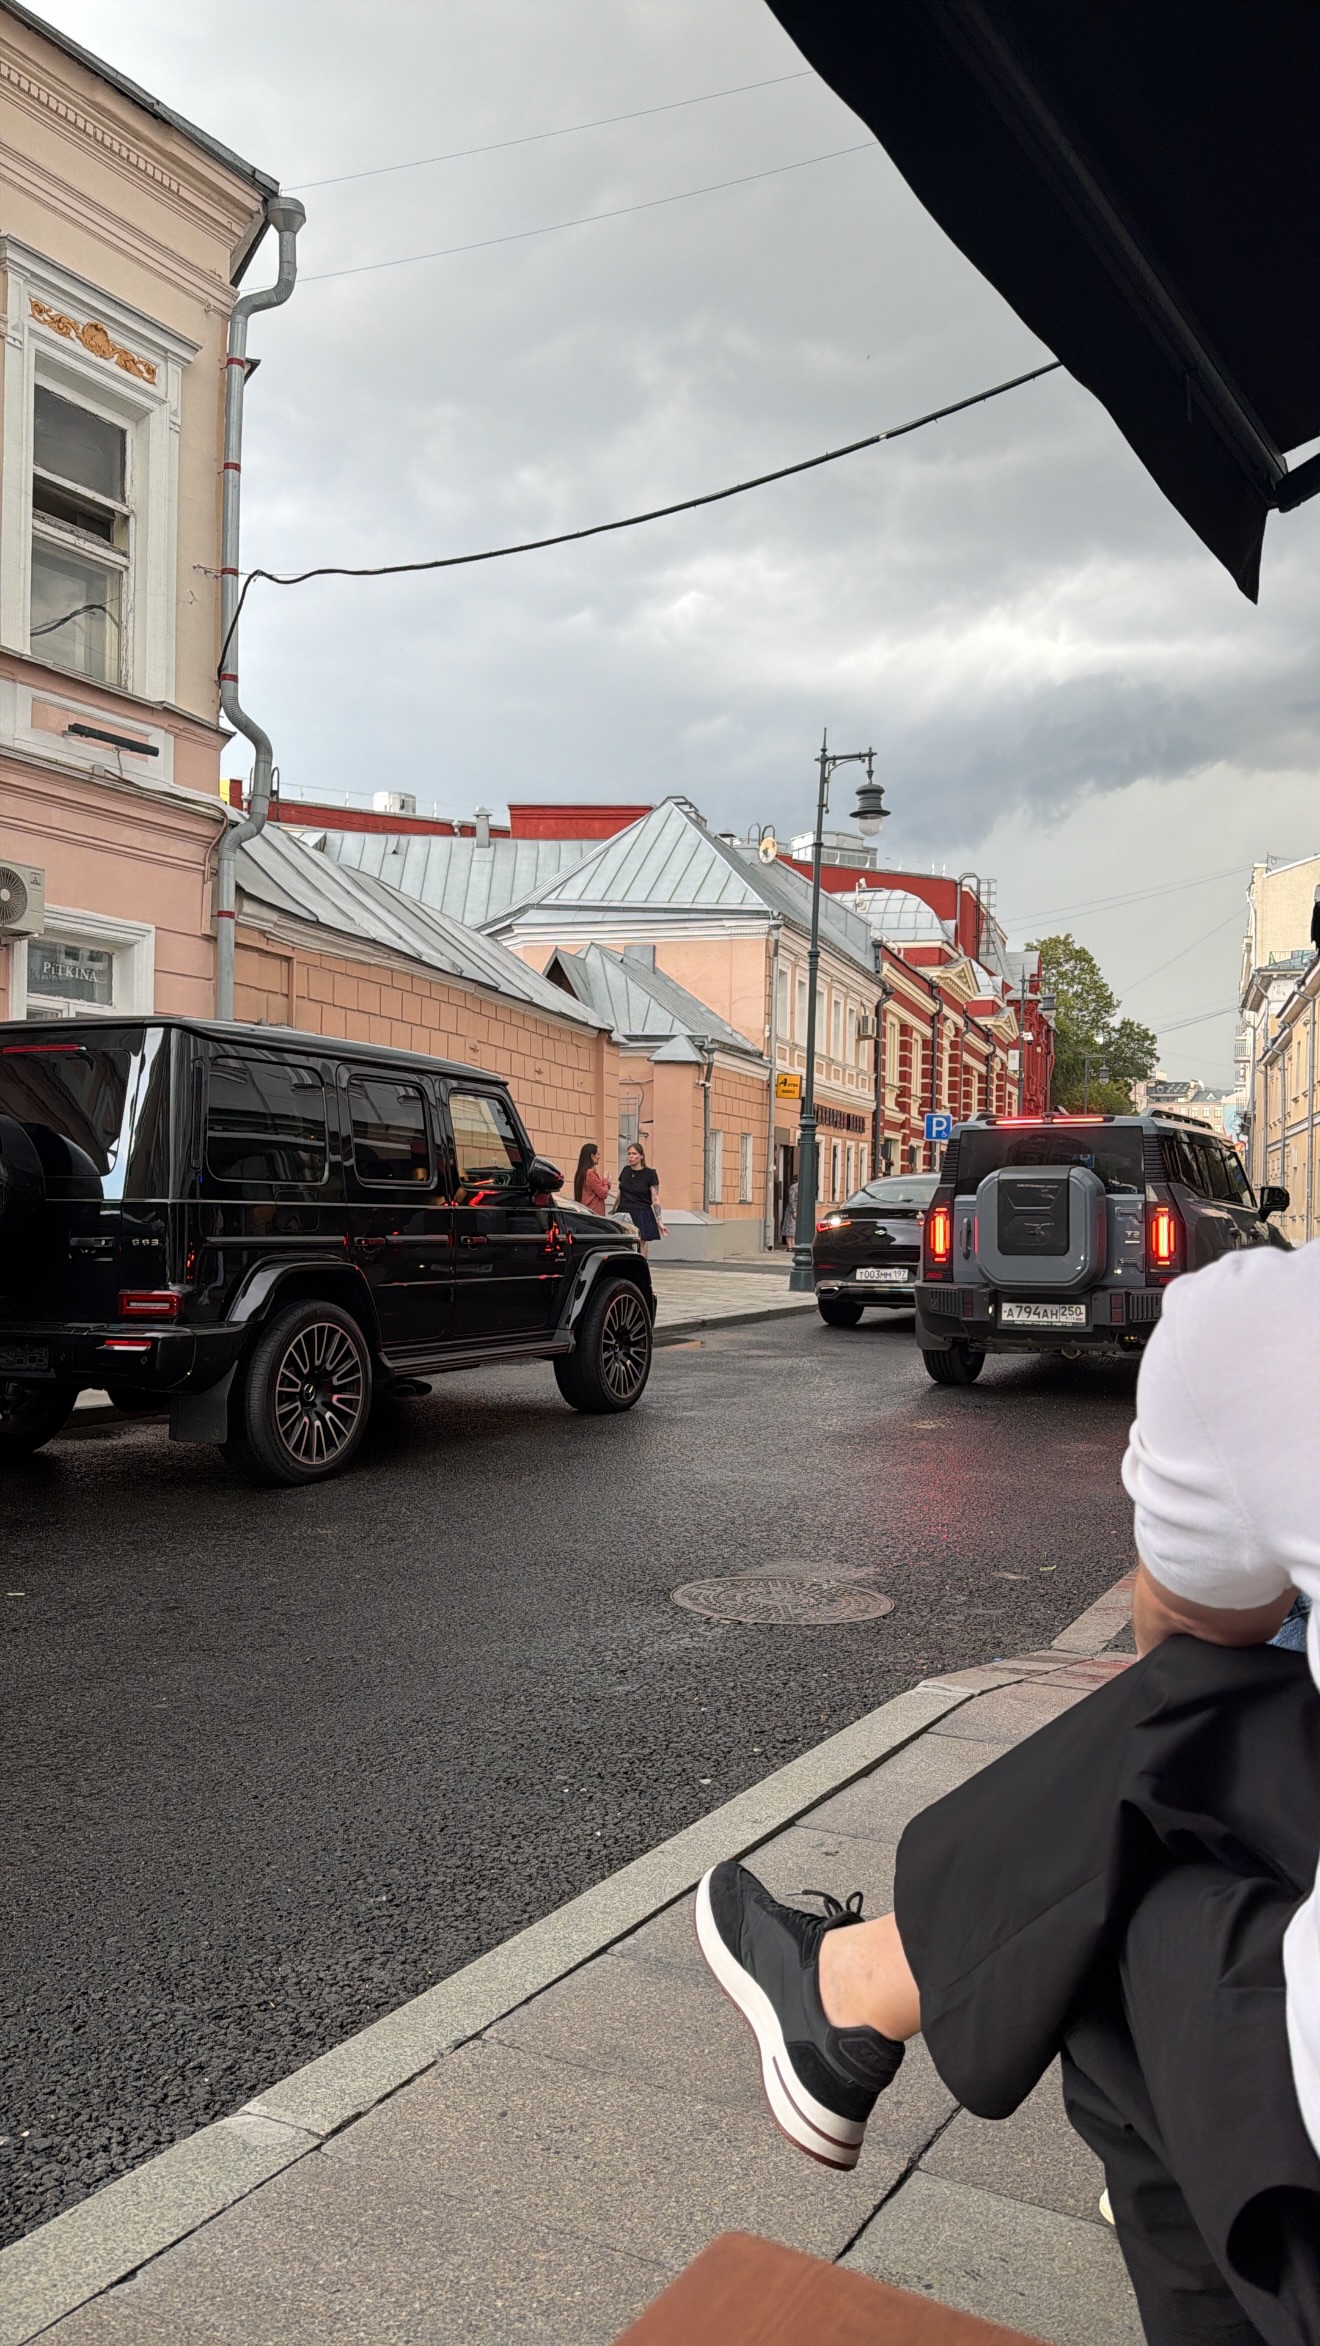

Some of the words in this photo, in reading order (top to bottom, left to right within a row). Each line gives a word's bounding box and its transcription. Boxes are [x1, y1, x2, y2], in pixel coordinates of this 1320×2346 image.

[43, 961, 98, 983] PiTKINA
[932, 1117, 947, 1137] P
[1061, 1306, 1083, 1316] 250
